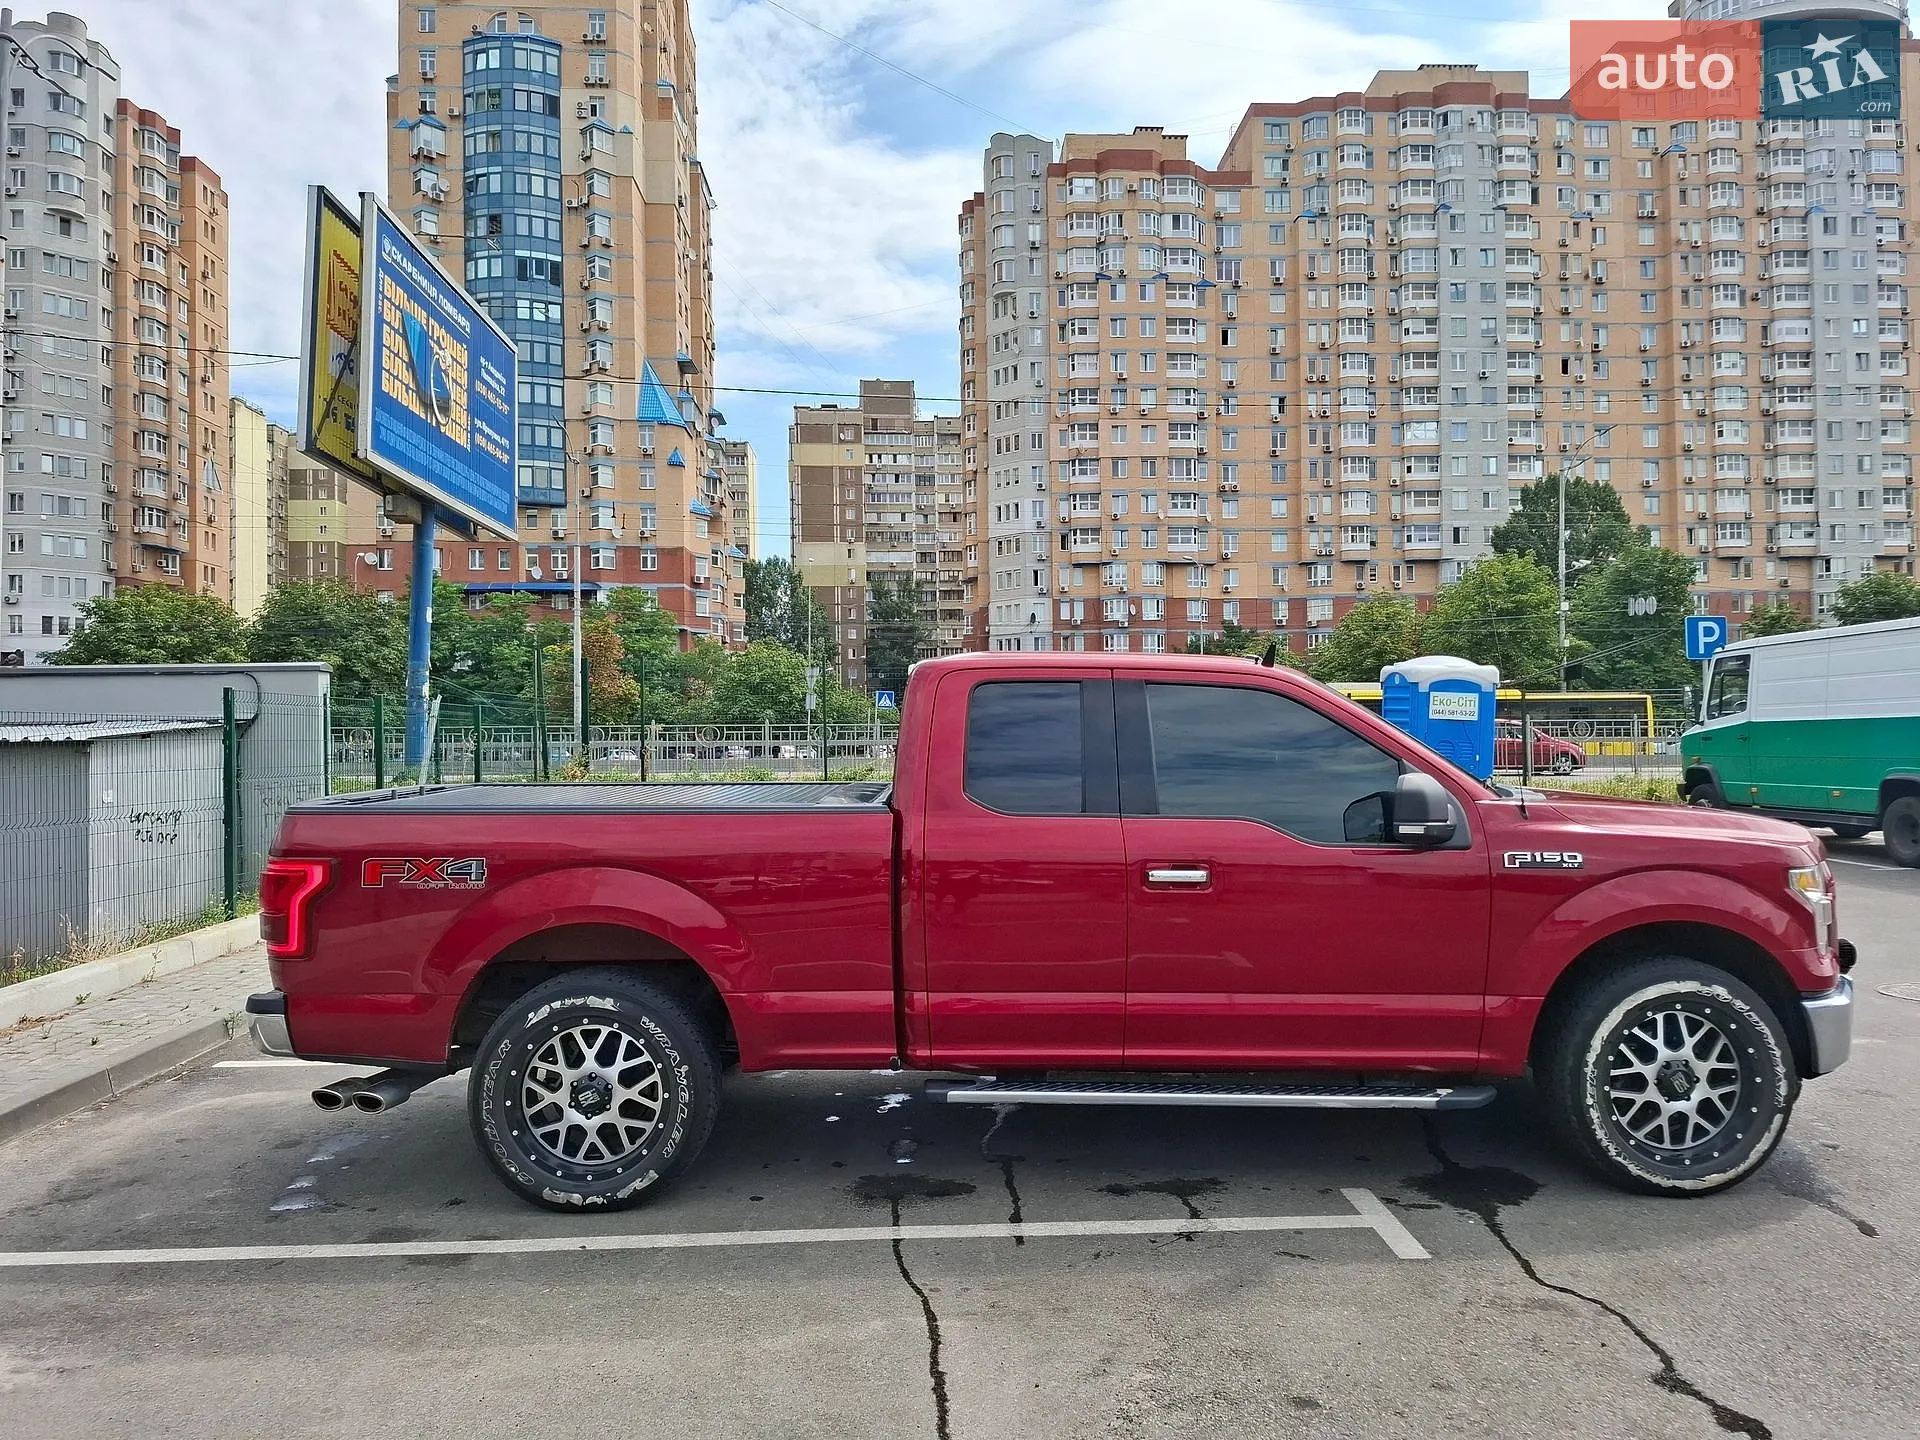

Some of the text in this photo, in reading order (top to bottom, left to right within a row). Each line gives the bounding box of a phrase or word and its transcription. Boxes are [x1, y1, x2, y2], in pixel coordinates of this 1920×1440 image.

[391, 246, 438, 300] СКАРБНИЦЯ
[384, 274, 428, 333] БІЛЬШЕ
[429, 316, 467, 370] ГРОШЕЙ
[382, 345, 416, 391] БІЛЬШ
[1698, 621, 1720, 654] P
[1432, 695, 1476, 708] Еко-Сіті
[1447, 709, 1477, 717] 581-53-22
[361, 857, 487, 888] FX4
[449, 882, 486, 890] ROAD
[638, 1015, 694, 1159] WRANGLER
[480, 1038, 535, 1186] GOODYEAR
